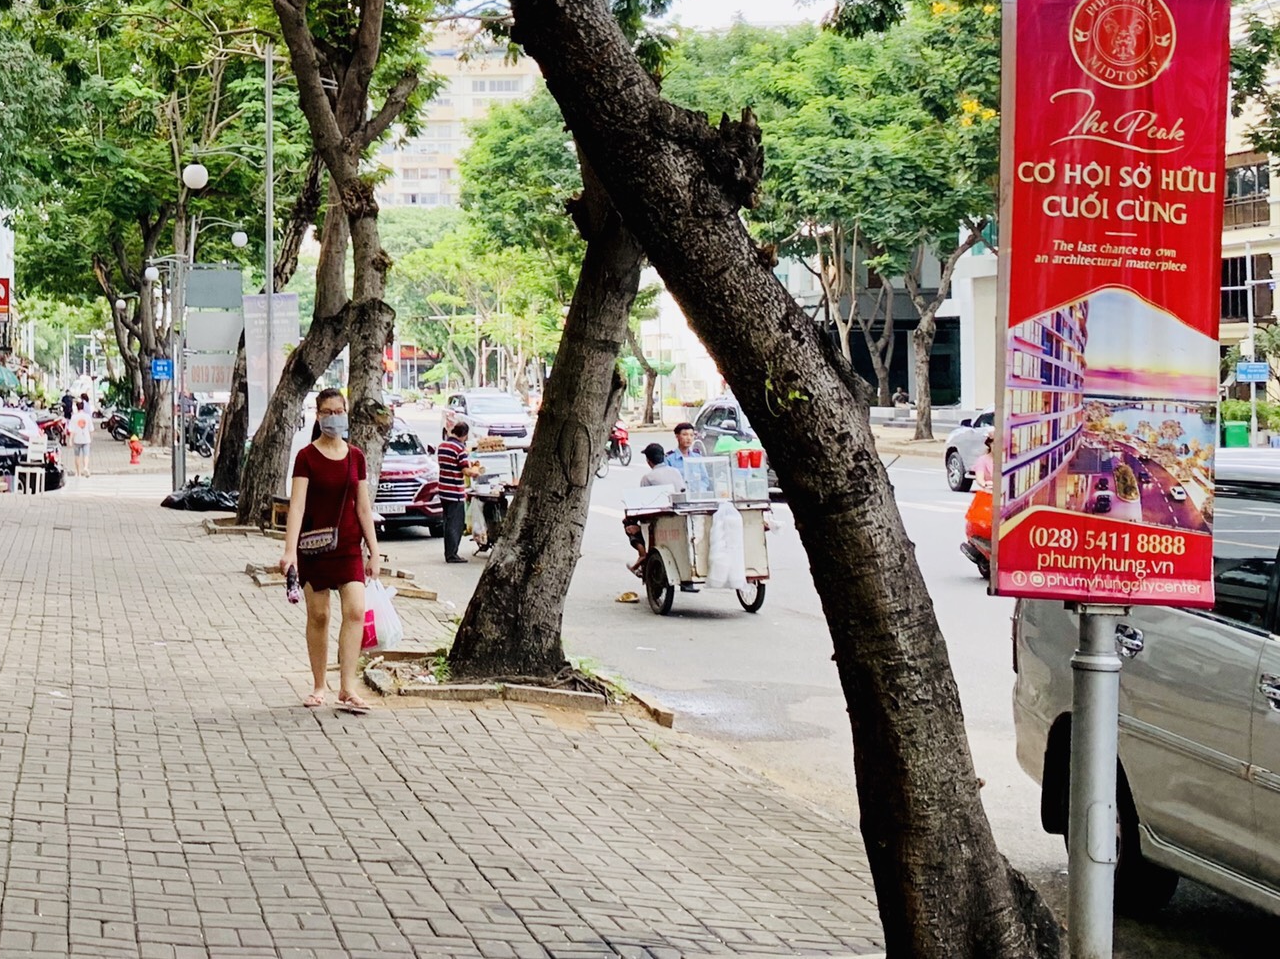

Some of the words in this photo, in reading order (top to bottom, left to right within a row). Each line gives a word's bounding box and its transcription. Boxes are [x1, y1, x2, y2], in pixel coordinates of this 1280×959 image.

[1089, 54, 1158, 82] MIDTOWN
[1049, 88, 1108, 136] The
[1114, 109, 1186, 142] Peak
[1017, 158, 1056, 183] CƠ
[1064, 161, 1111, 189] HỘI
[1119, 161, 1152, 189] SỞ
[1161, 166, 1216, 193] HỮU
[1042, 192, 1109, 220] CUỐI
[1116, 199, 1188, 225] CÙNG
[1034, 254, 1048, 263] an
[1052, 253, 1123, 268] architectural
[1125, 258, 1187, 272] masterpiece
[1052, 239, 1074, 252] The
[1077, 240, 1097, 253] last
[1100, 243, 1138, 255] chance
[1140, 247, 1151, 256] to
[1155, 248, 1177, 258] own
[1029, 525, 1079, 549] (028)
[1084, 530, 1131, 552] 5411
[1136, 533, 1186, 555] 8888
[1037, 551, 1174, 578] phumyhung.vn
[1047, 573, 1202, 595] phumyhungcitycenter
